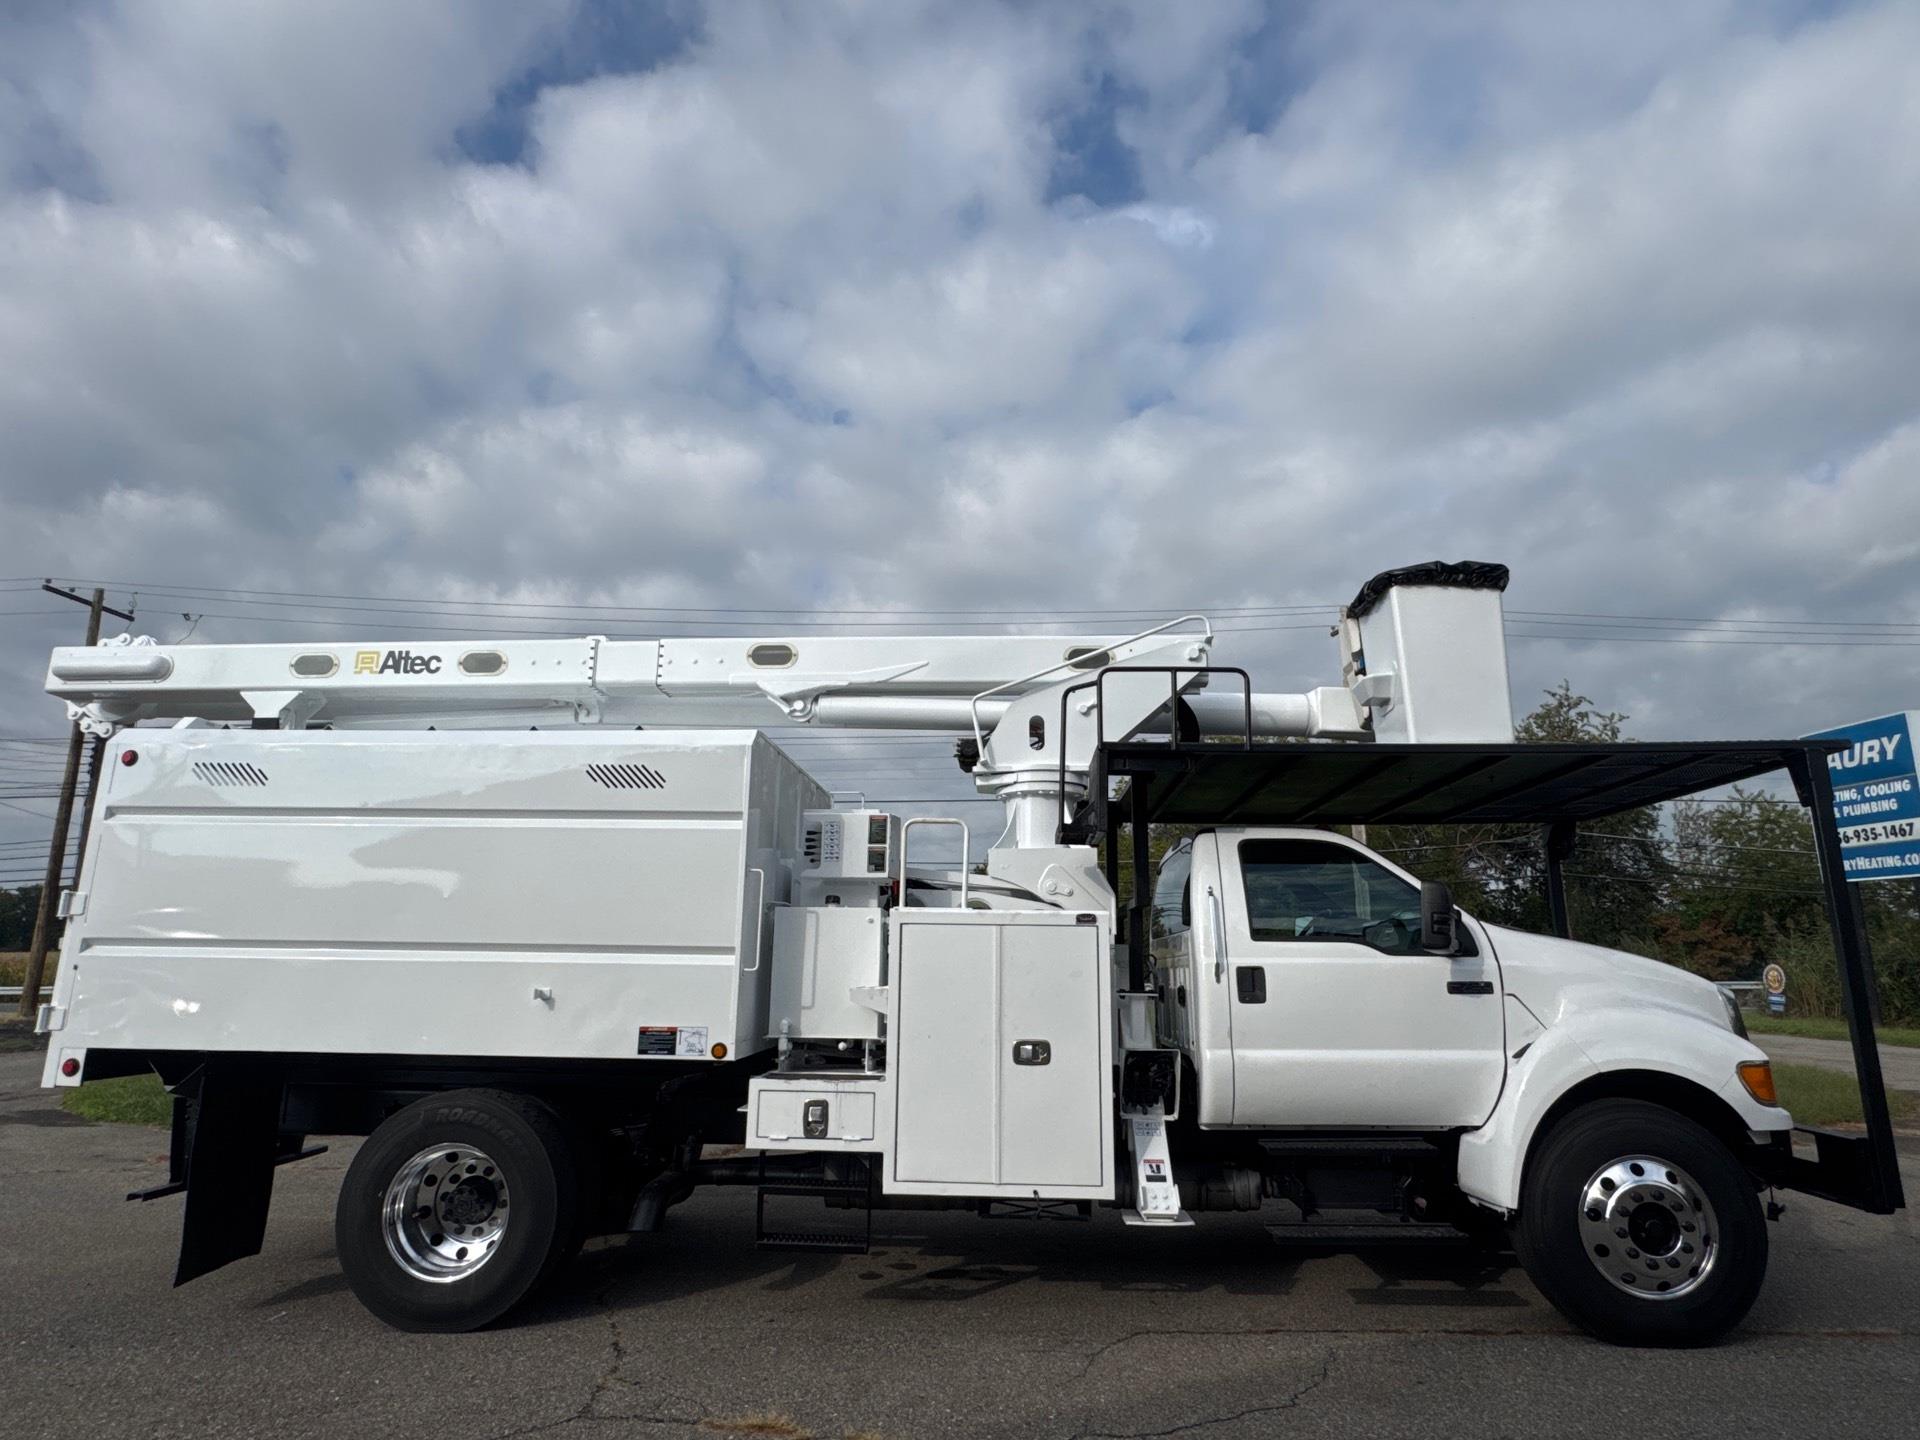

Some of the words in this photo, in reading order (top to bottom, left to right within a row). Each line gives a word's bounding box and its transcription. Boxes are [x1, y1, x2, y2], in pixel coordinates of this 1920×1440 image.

[379, 650, 442, 674] Altec
[1827, 733, 1902, 770] AURY
[1834, 787, 1862, 803] TING,
[1864, 779, 1911, 798] COOLING
[1843, 798, 1898, 817] PLUMBING
[1843, 853, 1920, 871] RYHEATING.CO
